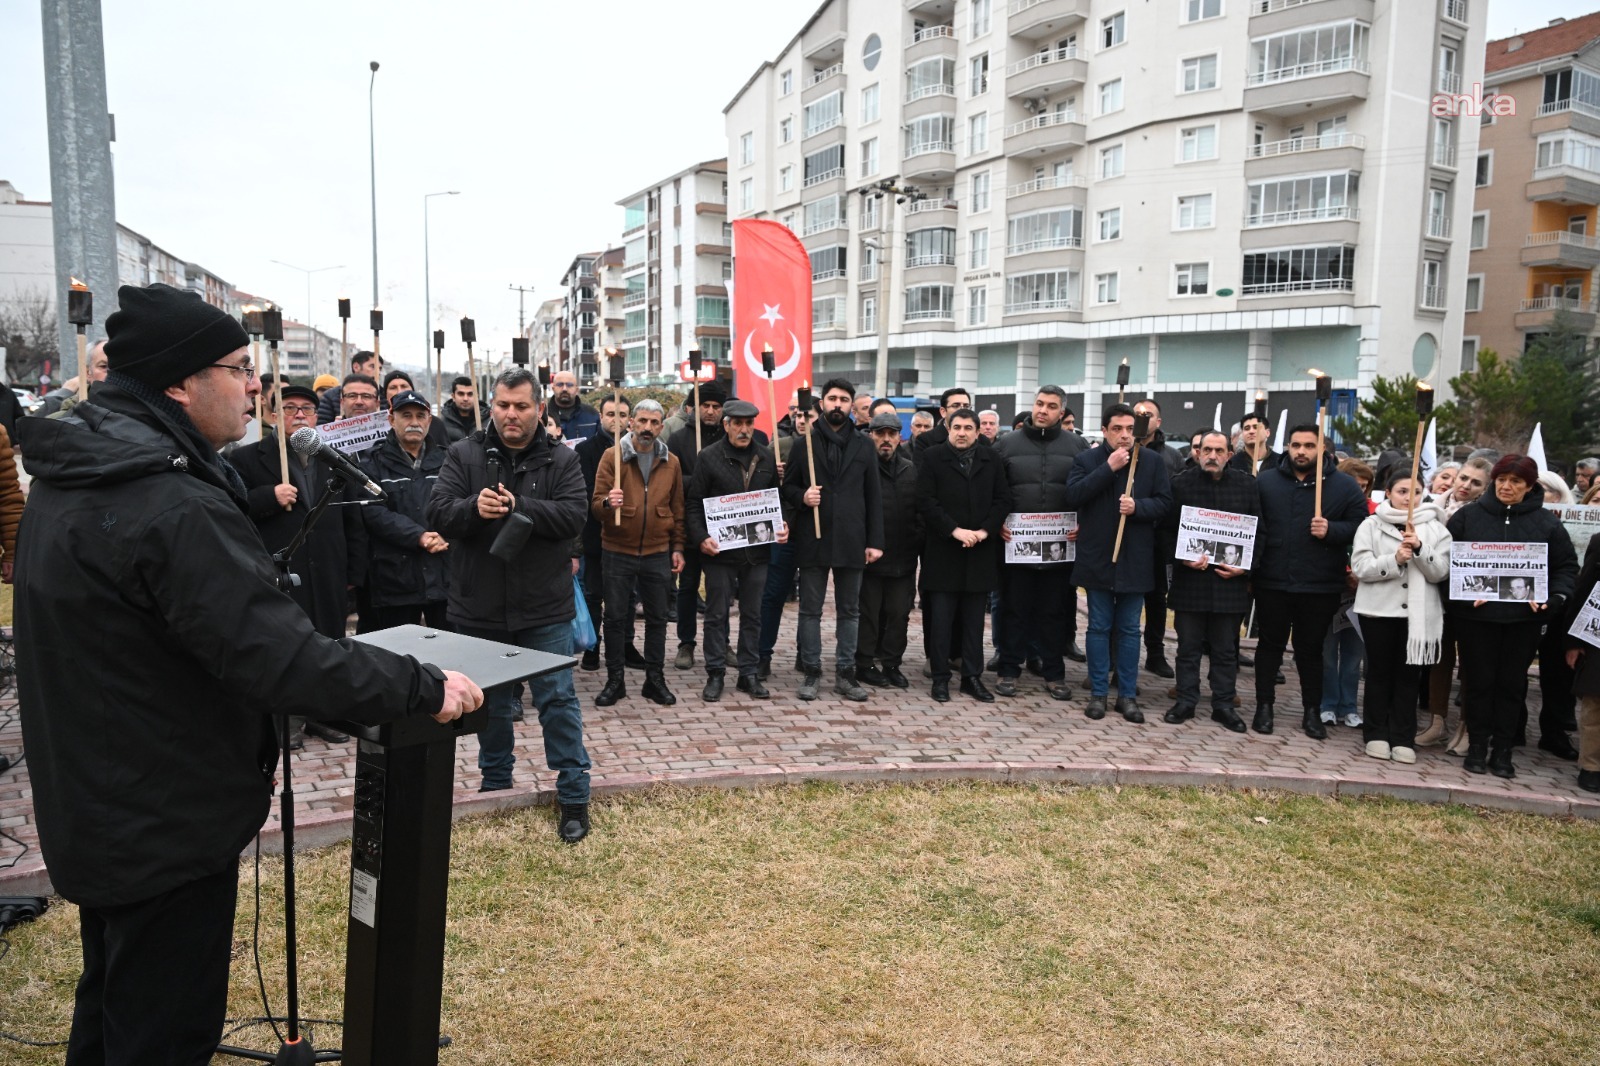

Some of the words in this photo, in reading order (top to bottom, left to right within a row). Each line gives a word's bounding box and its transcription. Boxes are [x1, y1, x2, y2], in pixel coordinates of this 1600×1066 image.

[322, 415, 372, 432] Cumhuriyet
[720, 492, 762, 503] Cumhuriyet
[707, 506, 779, 522] Susturamazlar
[1198, 509, 1240, 521] Cumhuriyet
[1565, 508, 1582, 520] ÖNE
[1180, 522, 1254, 540] Susturamazlar
[1471, 542, 1526, 551] Cumhuriyet
[1452, 560, 1546, 570] Susturamazlar
